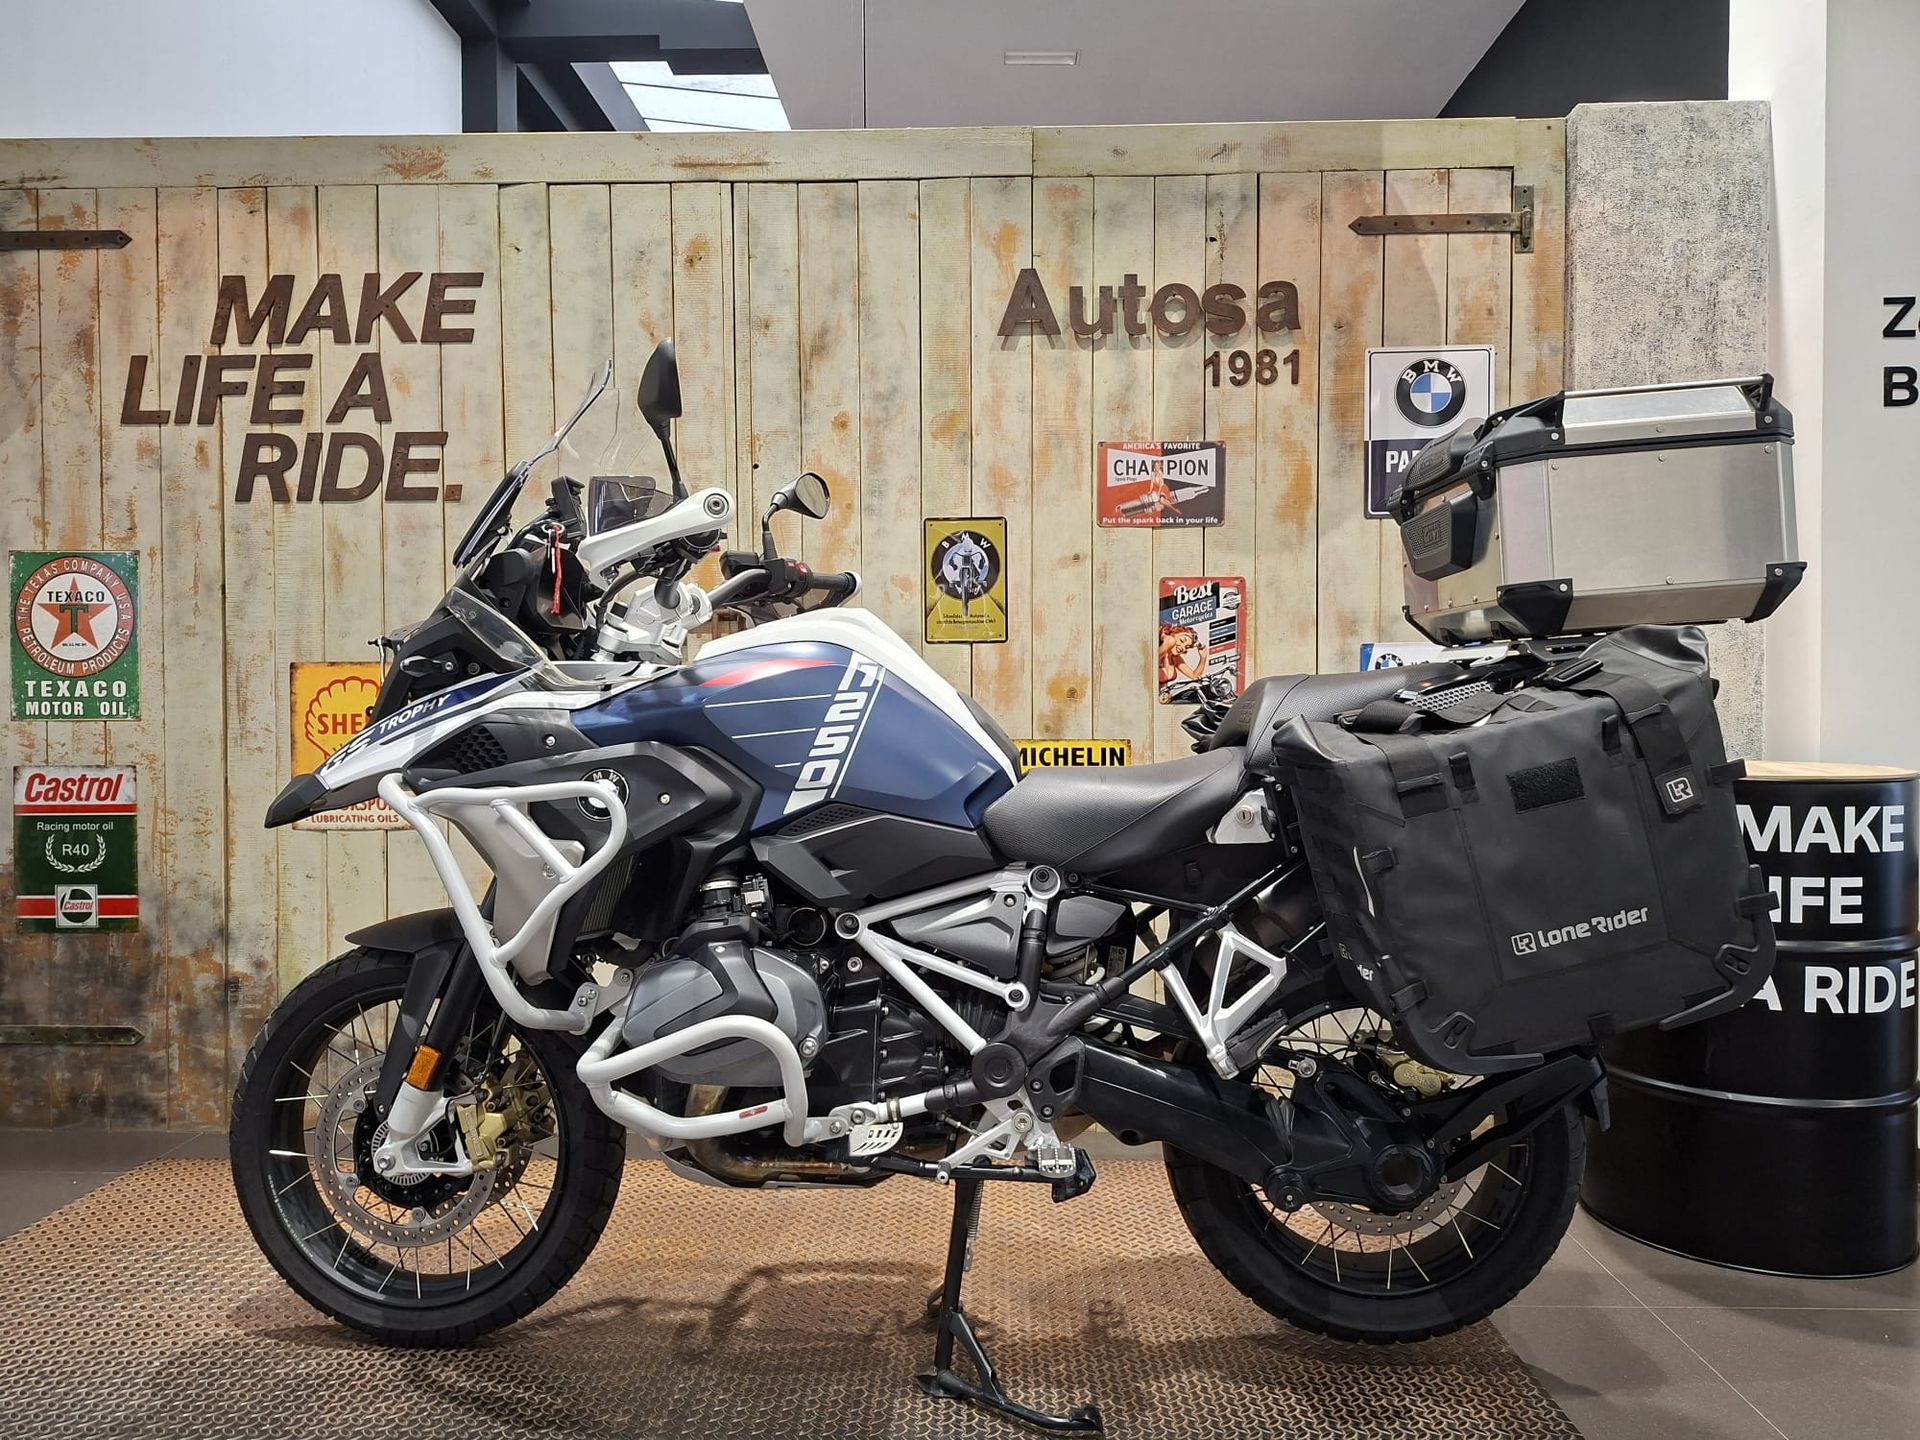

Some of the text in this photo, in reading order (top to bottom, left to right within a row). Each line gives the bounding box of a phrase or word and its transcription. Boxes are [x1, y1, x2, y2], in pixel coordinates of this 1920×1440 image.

[210, 272, 485, 345] MAKE
[997, 269, 1301, 336] Autosa
[1883, 296, 1920, 338] Z
[1204, 349, 1300, 387] 1981
[1401, 360, 1462, 384] BMW
[120, 352, 392, 425] LIFE A
[1123, 442, 1201, 450] AMERICA'S FAVORITE
[235, 431, 463, 502] RIDE.
[1385, 450, 1420, 473] PA
[1119, 516, 1131, 524] the
[1133, 516, 1156, 525] spark
[1156, 516, 1174, 524] back
[1176, 516, 1184, 524] in
[1185, 518, 1204, 526] your
[1205, 516, 1219, 524] life
[941, 532, 991, 549] BMW
[17, 598, 31, 620] THE
[24, 563, 59, 594] TEXAS
[63, 559, 121, 587] COMPANY
[47, 590, 106, 603] TEXACO
[1174, 580, 1214, 605] Best
[1172, 599, 1214, 621] GARAGE
[19, 627, 130, 675] PETROLEUM PRODUCTS
[25, 680, 128, 697] TEXACO
[25, 701, 128, 716] MOTOR OIL
[380, 694, 452, 734] TROPHY
[317, 713, 369, 735] SHE
[320, 728, 376, 775] GS
[24, 773, 124, 803] Castrol
[36, 821, 114, 833] Racing motor oil
[311, 814, 400, 823] LUBRICATING OILS
[1736, 804, 1905, 853] MAKE
[61, 843, 90, 857] R40
[63, 899, 94, 911] Castrol
[1768, 876, 1863, 924] IFE
[1591, 907, 1649, 933] Rider
[1804, 960, 1916, 1014] RIDE
